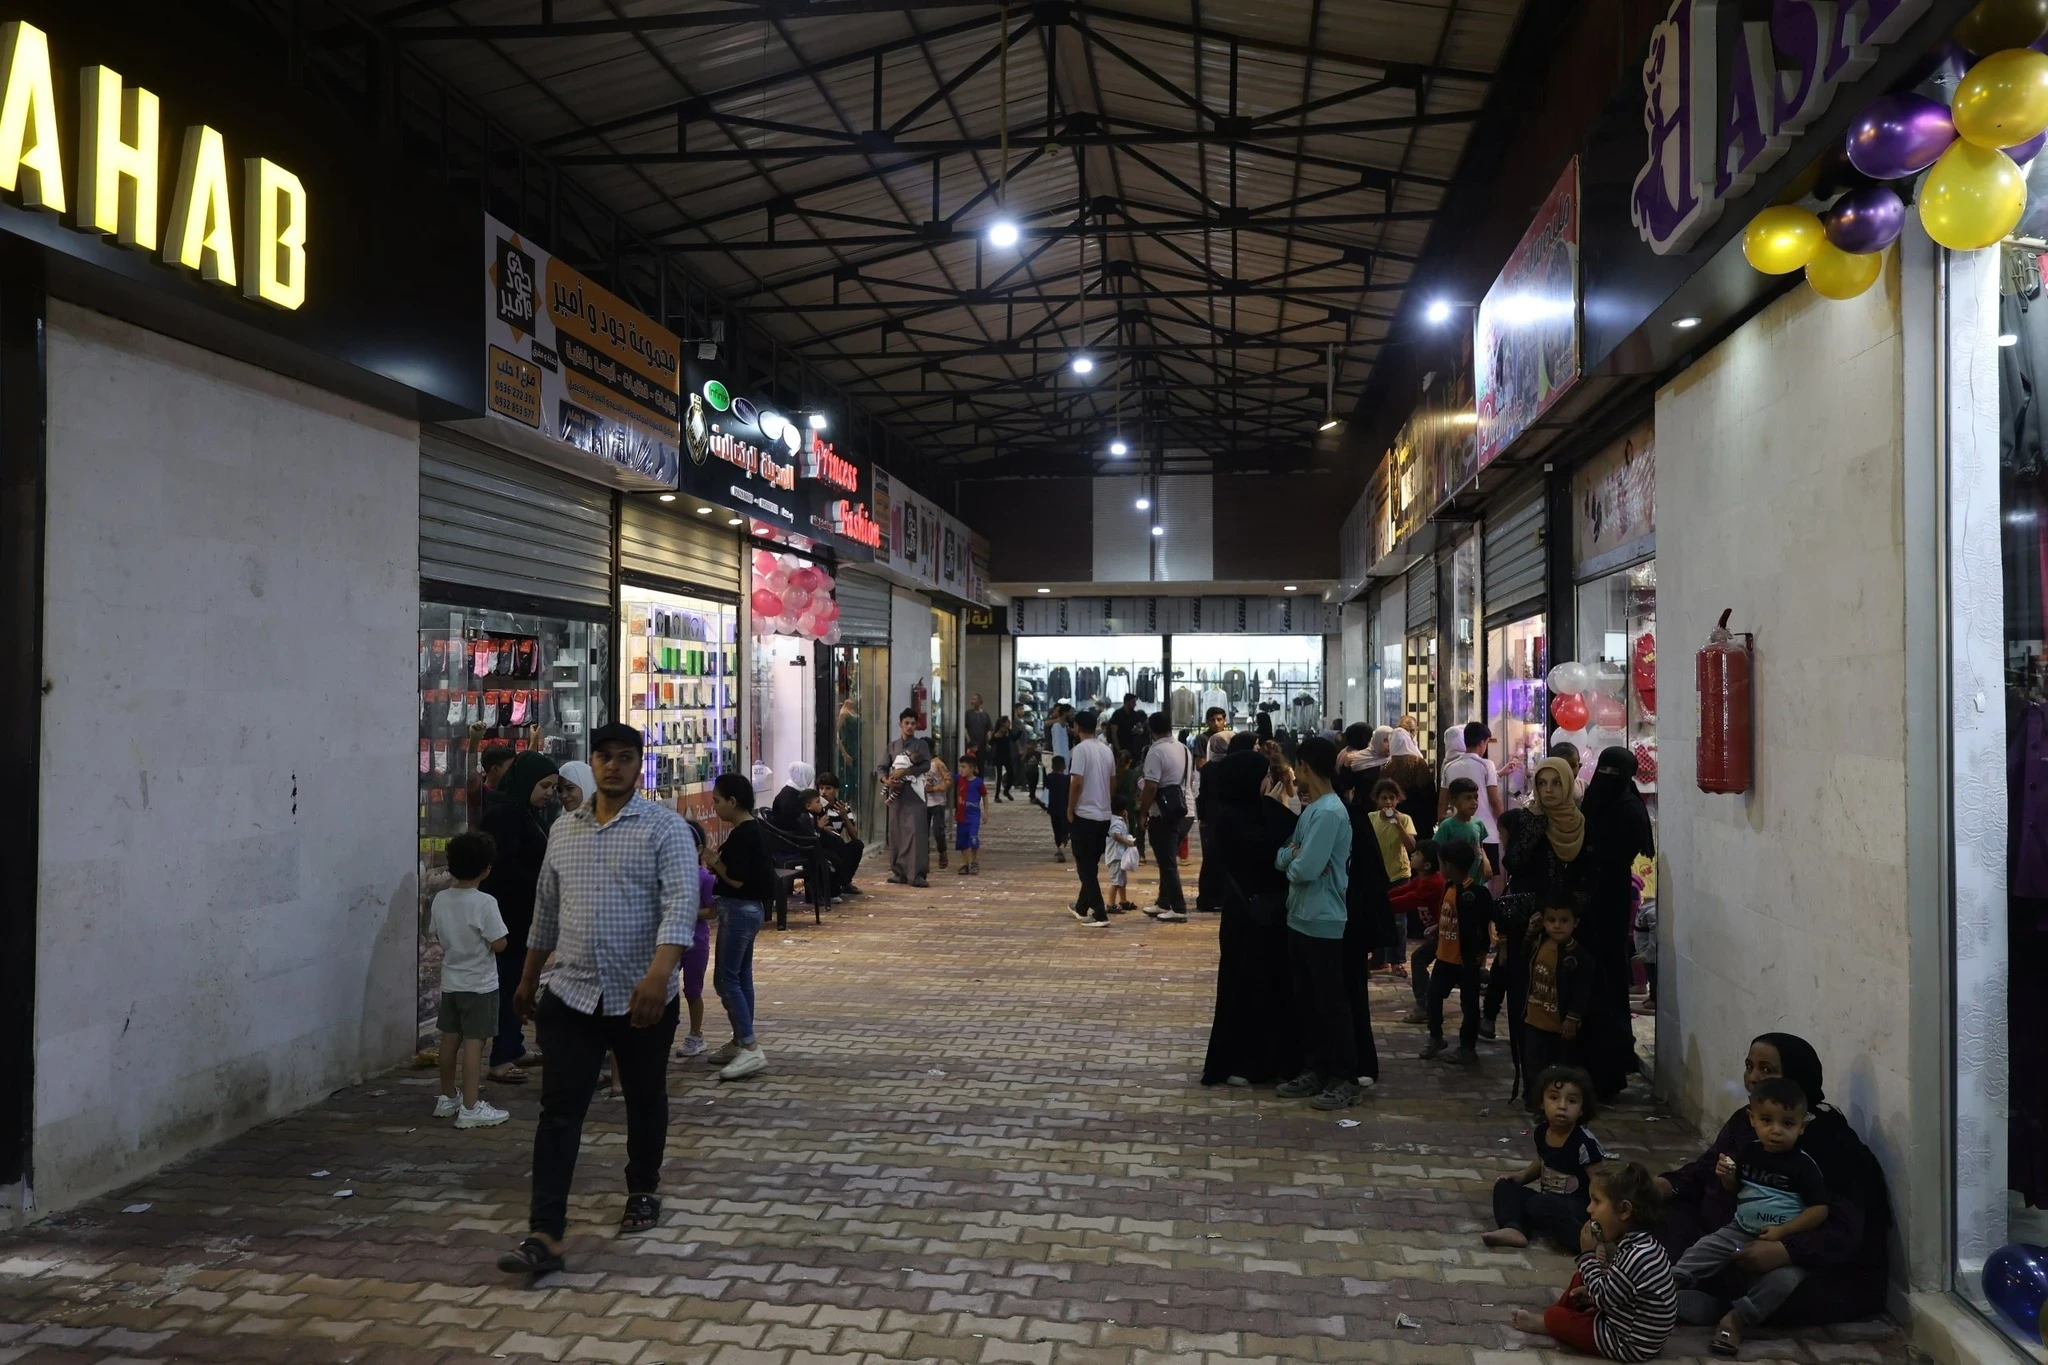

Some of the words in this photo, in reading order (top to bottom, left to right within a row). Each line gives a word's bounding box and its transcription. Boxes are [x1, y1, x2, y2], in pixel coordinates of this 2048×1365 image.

[0, 20, 307, 311] AHAB
[553, 278, 584, 320] أمير
[589, 303, 597, 334] و
[601, 309, 627, 347] جود
[496, 358, 513, 377] حلب
[629, 321, 676, 380] مجموعة
[812, 428, 858, 492] Princess
[838, 499, 880, 549] Fashion
[1148, 598, 1157, 630] TRUST
[1193, 597, 1201, 630] TRUST
[1238, 597, 1247, 631] TRUST
[1543, 1002, 1557, 1012] 55
[1756, 1212, 1787, 1224] NIKE
